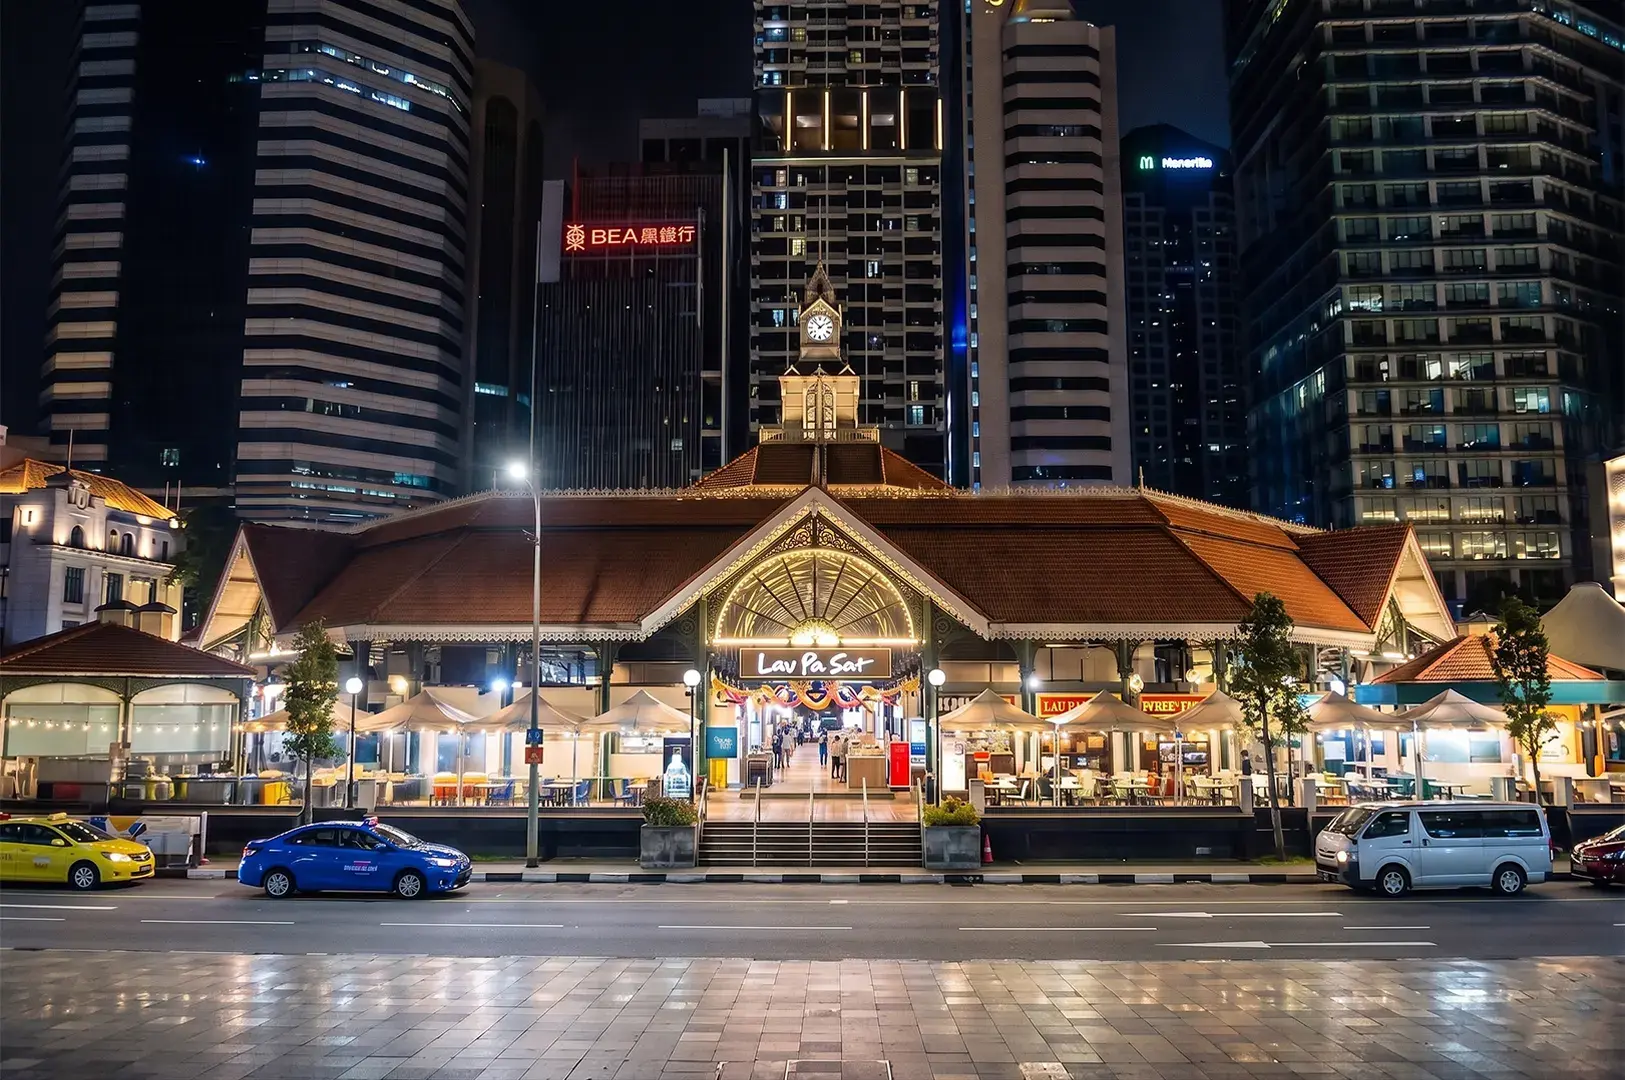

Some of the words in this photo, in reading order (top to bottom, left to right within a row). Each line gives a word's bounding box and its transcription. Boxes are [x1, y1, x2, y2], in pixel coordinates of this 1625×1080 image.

[591, 228, 639, 245] BEA
[801, 651, 827, 676] Pa
[829, 652, 875, 675] Sat
[1043, 701, 1066, 712] LAU
